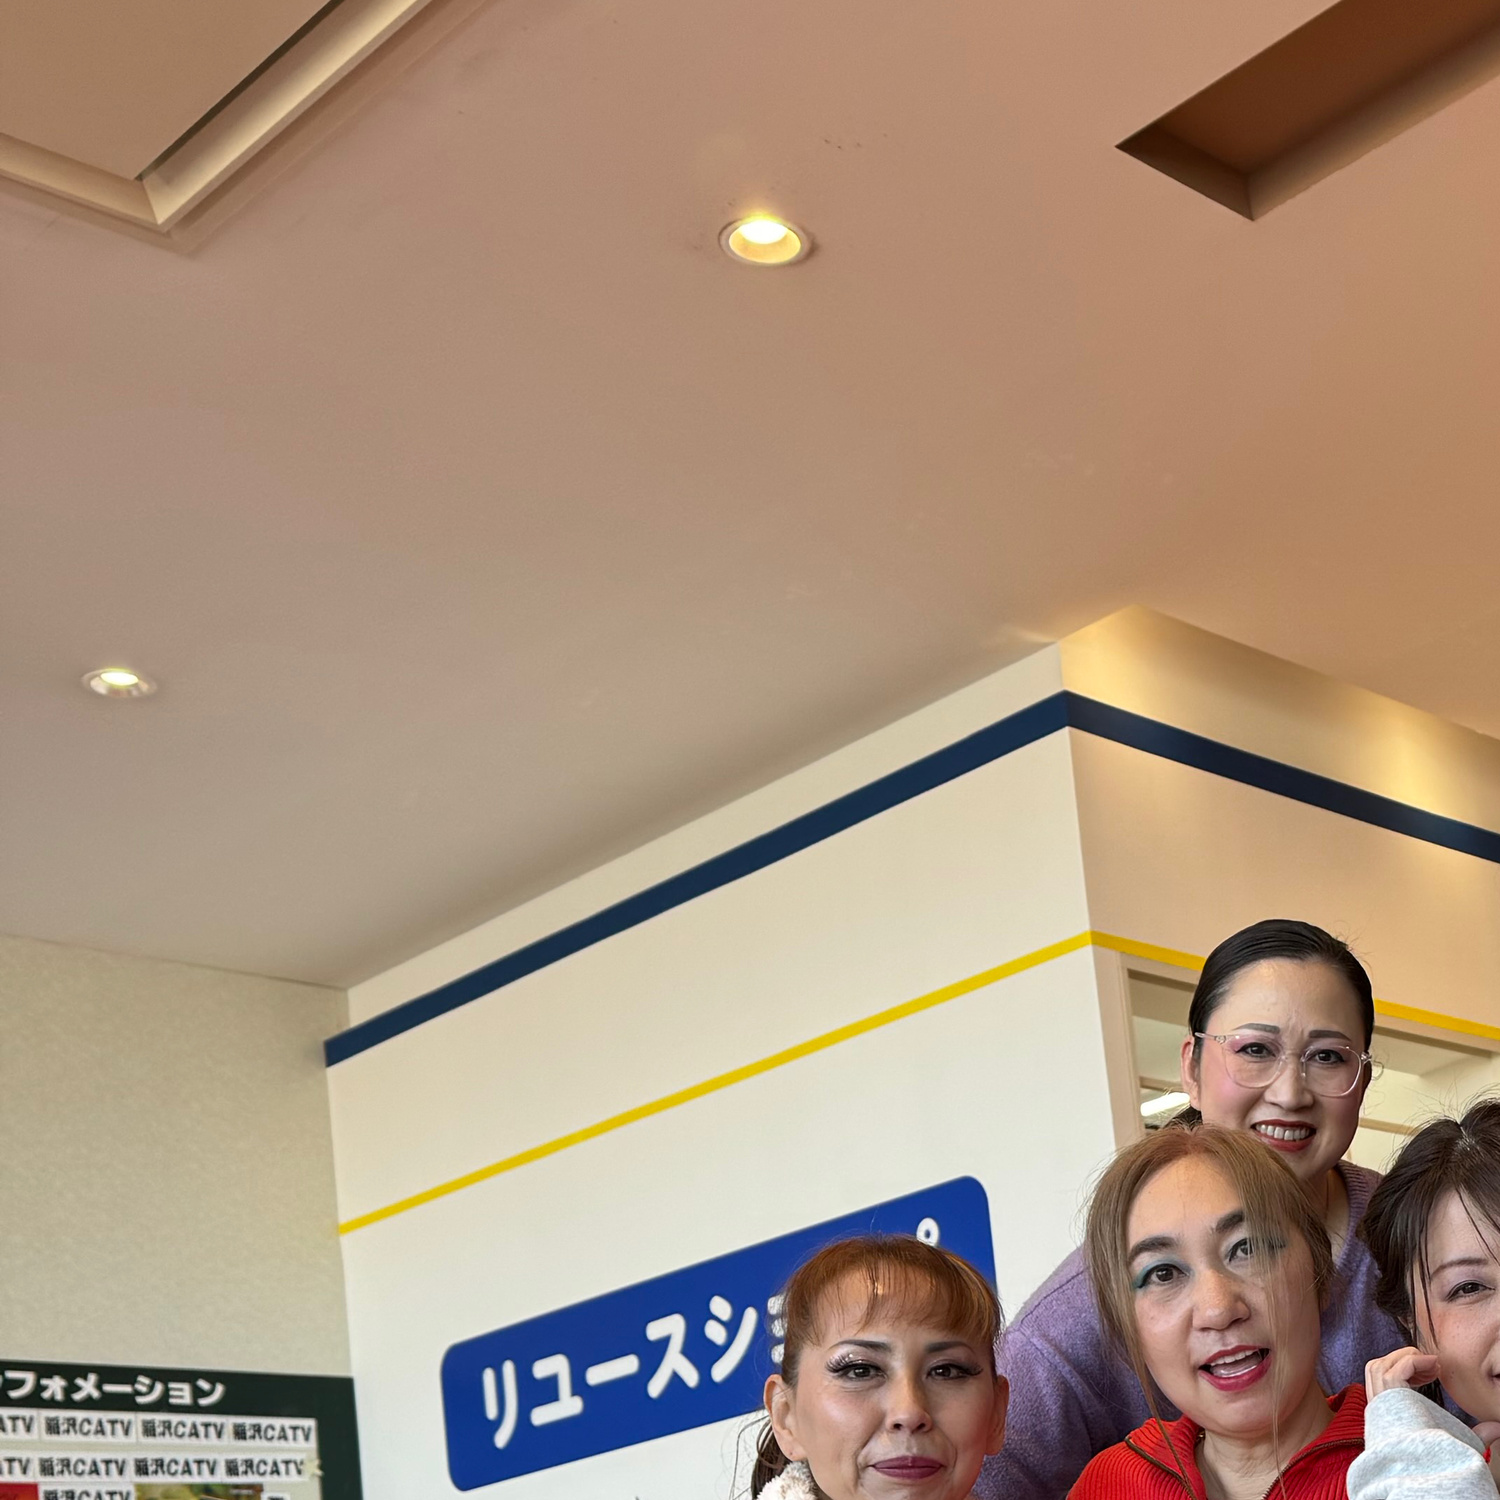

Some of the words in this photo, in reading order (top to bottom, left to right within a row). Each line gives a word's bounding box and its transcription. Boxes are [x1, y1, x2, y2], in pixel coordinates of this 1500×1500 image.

[0, 1370, 226, 1407] フォメーション
